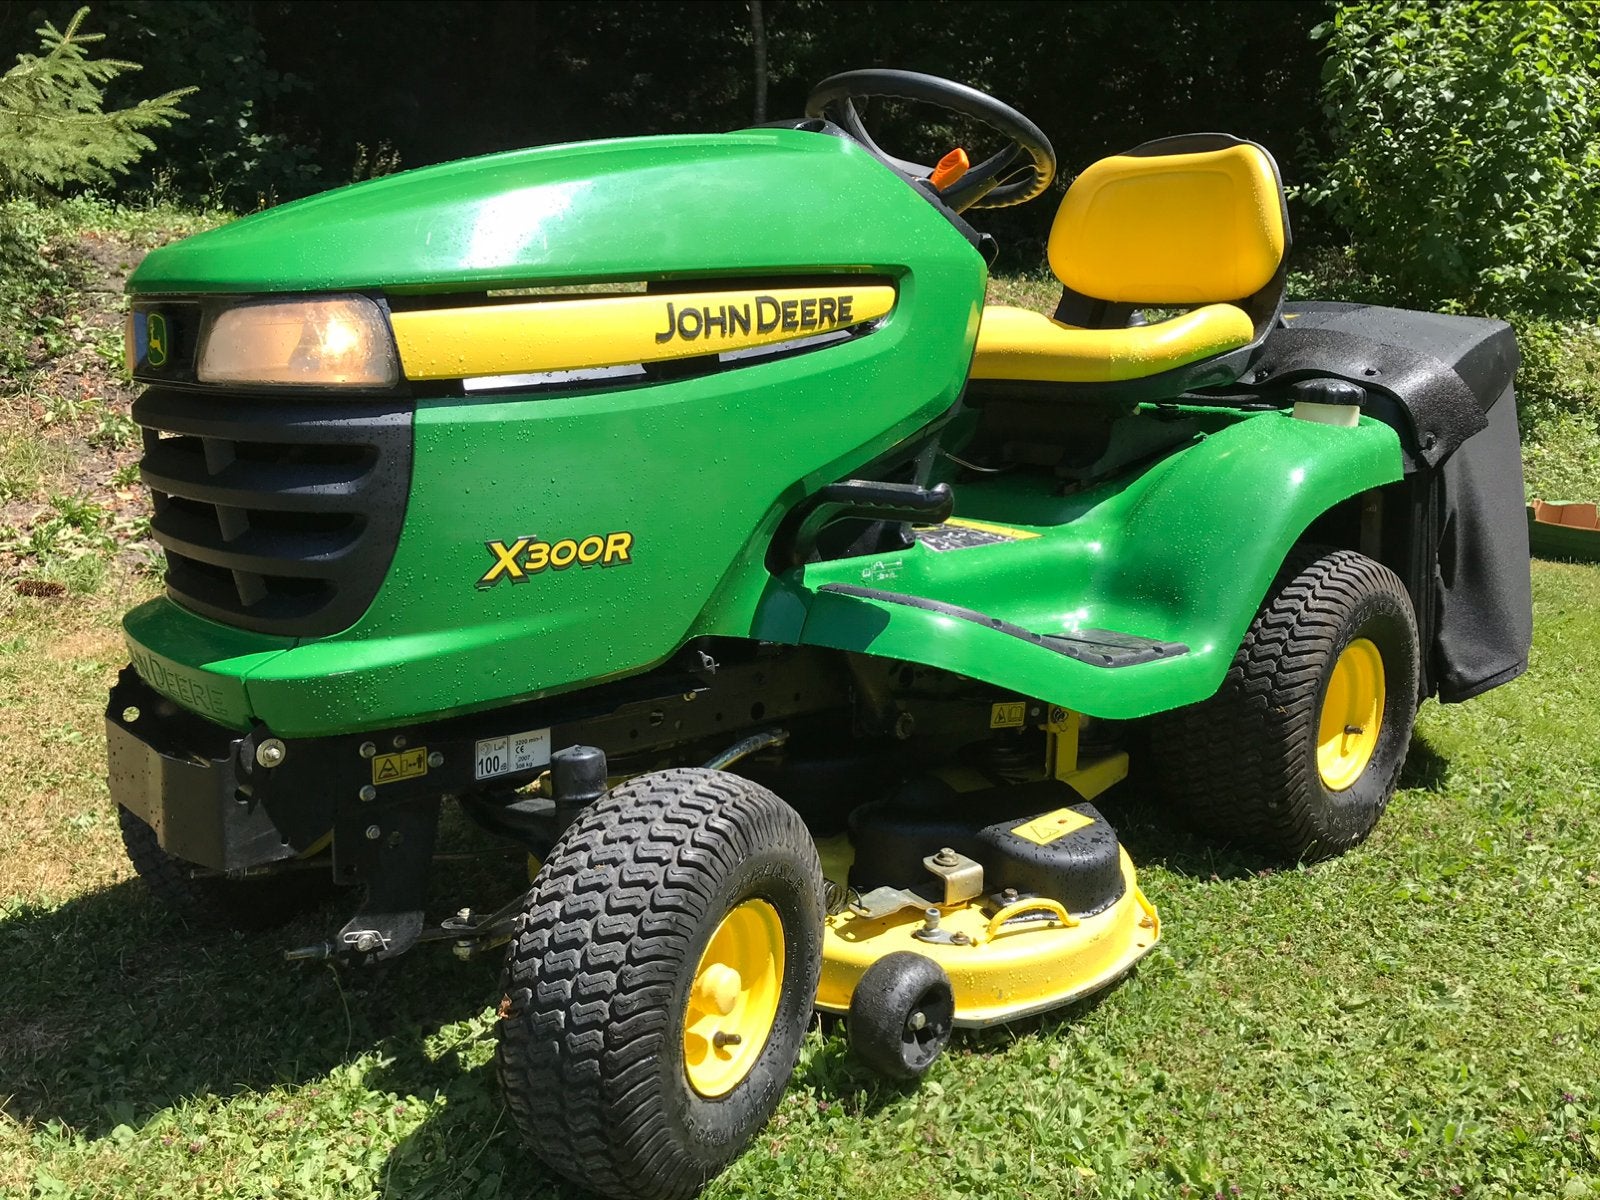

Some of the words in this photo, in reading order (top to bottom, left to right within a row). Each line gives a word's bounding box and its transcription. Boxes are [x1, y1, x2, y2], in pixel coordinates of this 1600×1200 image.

[655, 302, 751, 344] JOHN
[755, 295, 854, 334] DEERE
[475, 531, 633, 588] X300R
[149, 654, 229, 716] DEERE
[478, 755, 500, 775] 100
